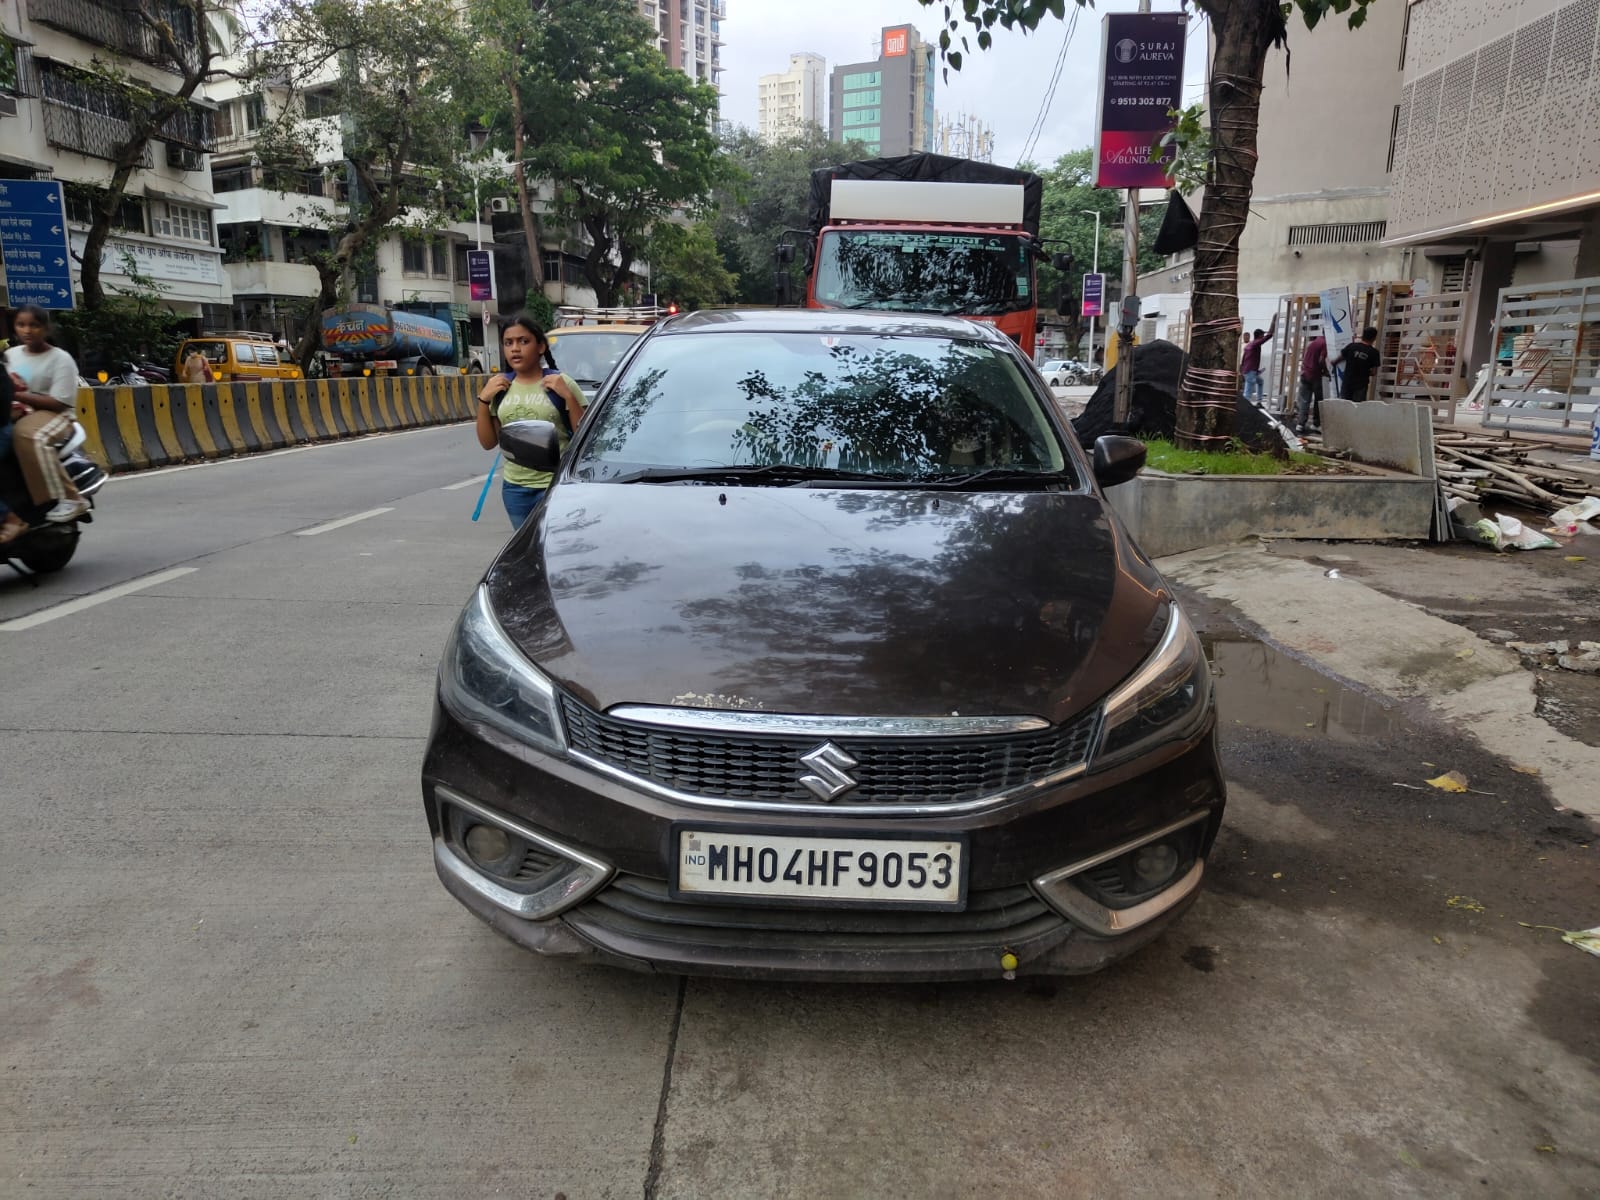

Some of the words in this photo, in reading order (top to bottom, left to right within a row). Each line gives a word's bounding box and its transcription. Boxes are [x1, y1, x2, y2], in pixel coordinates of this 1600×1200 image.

[1140, 42, 1175, 51] SURAJ
[1139, 52, 1174, 61] AUREVA
[1117, 97, 1137, 106] 9513
[1138, 97, 1154, 106] 302
[1156, 97, 1172, 106] 877
[1125, 146, 1133, 155] A
[1135, 146, 1152, 155] LIFE
[926, 235, 985, 245] POINT
[501, 394, 520, 405] OD
[685, 855, 705, 866] IND
[708, 844, 953, 890] MH04HF9053
